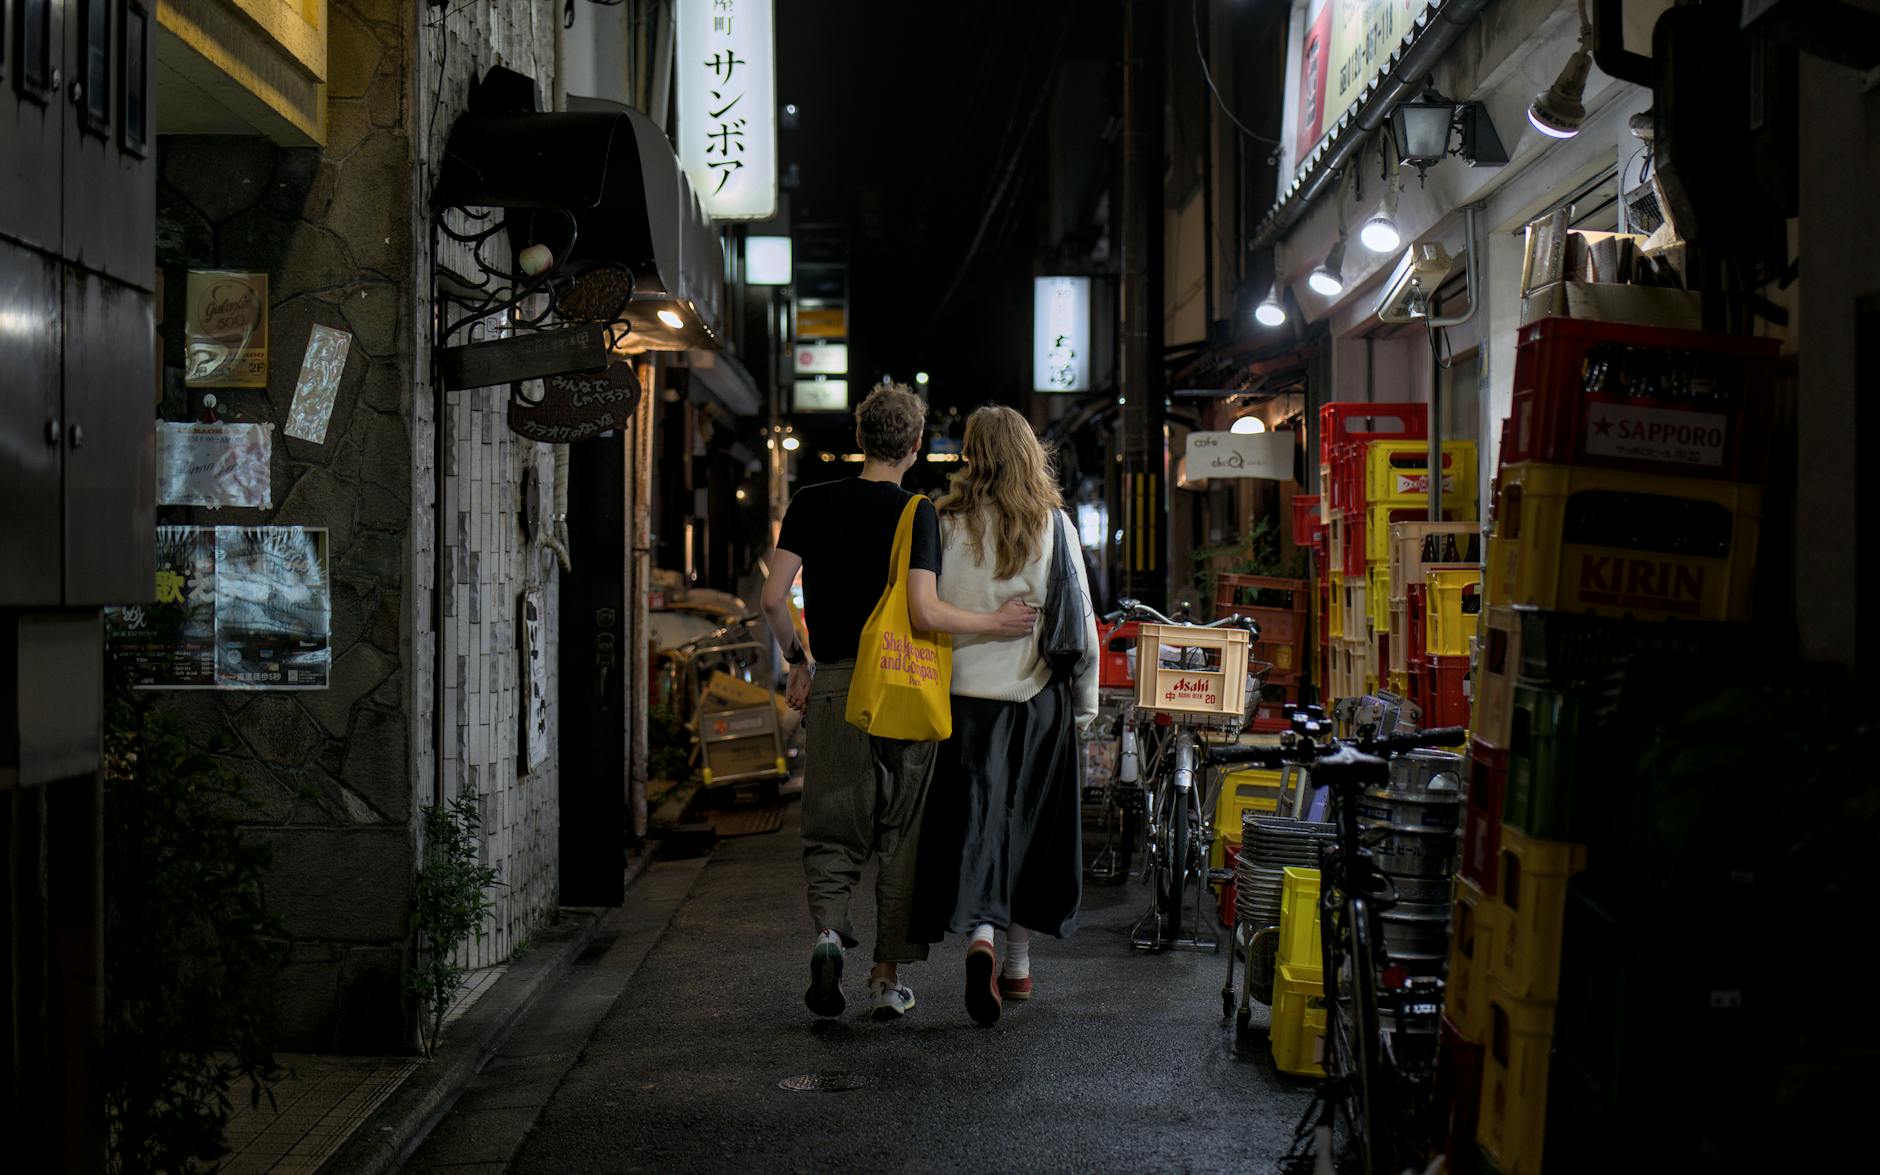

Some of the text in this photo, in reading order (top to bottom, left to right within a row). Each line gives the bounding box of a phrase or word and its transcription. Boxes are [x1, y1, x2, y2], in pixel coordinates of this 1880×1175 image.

[704, 49, 746, 196] サンボア
[249, 362, 264, 373] 2F
[551, 375, 608, 393] みんなで
[1617, 418, 1722, 448] SAPPORO
[1581, 554, 1706, 599] KIRIN
[882, 631, 937, 663] Shakpeare
[880, 652, 902, 671] and
[1173, 678, 1209, 692] Asahi
[1165, 691, 1176, 702] 中
[1205, 694, 1216, 704] 20
